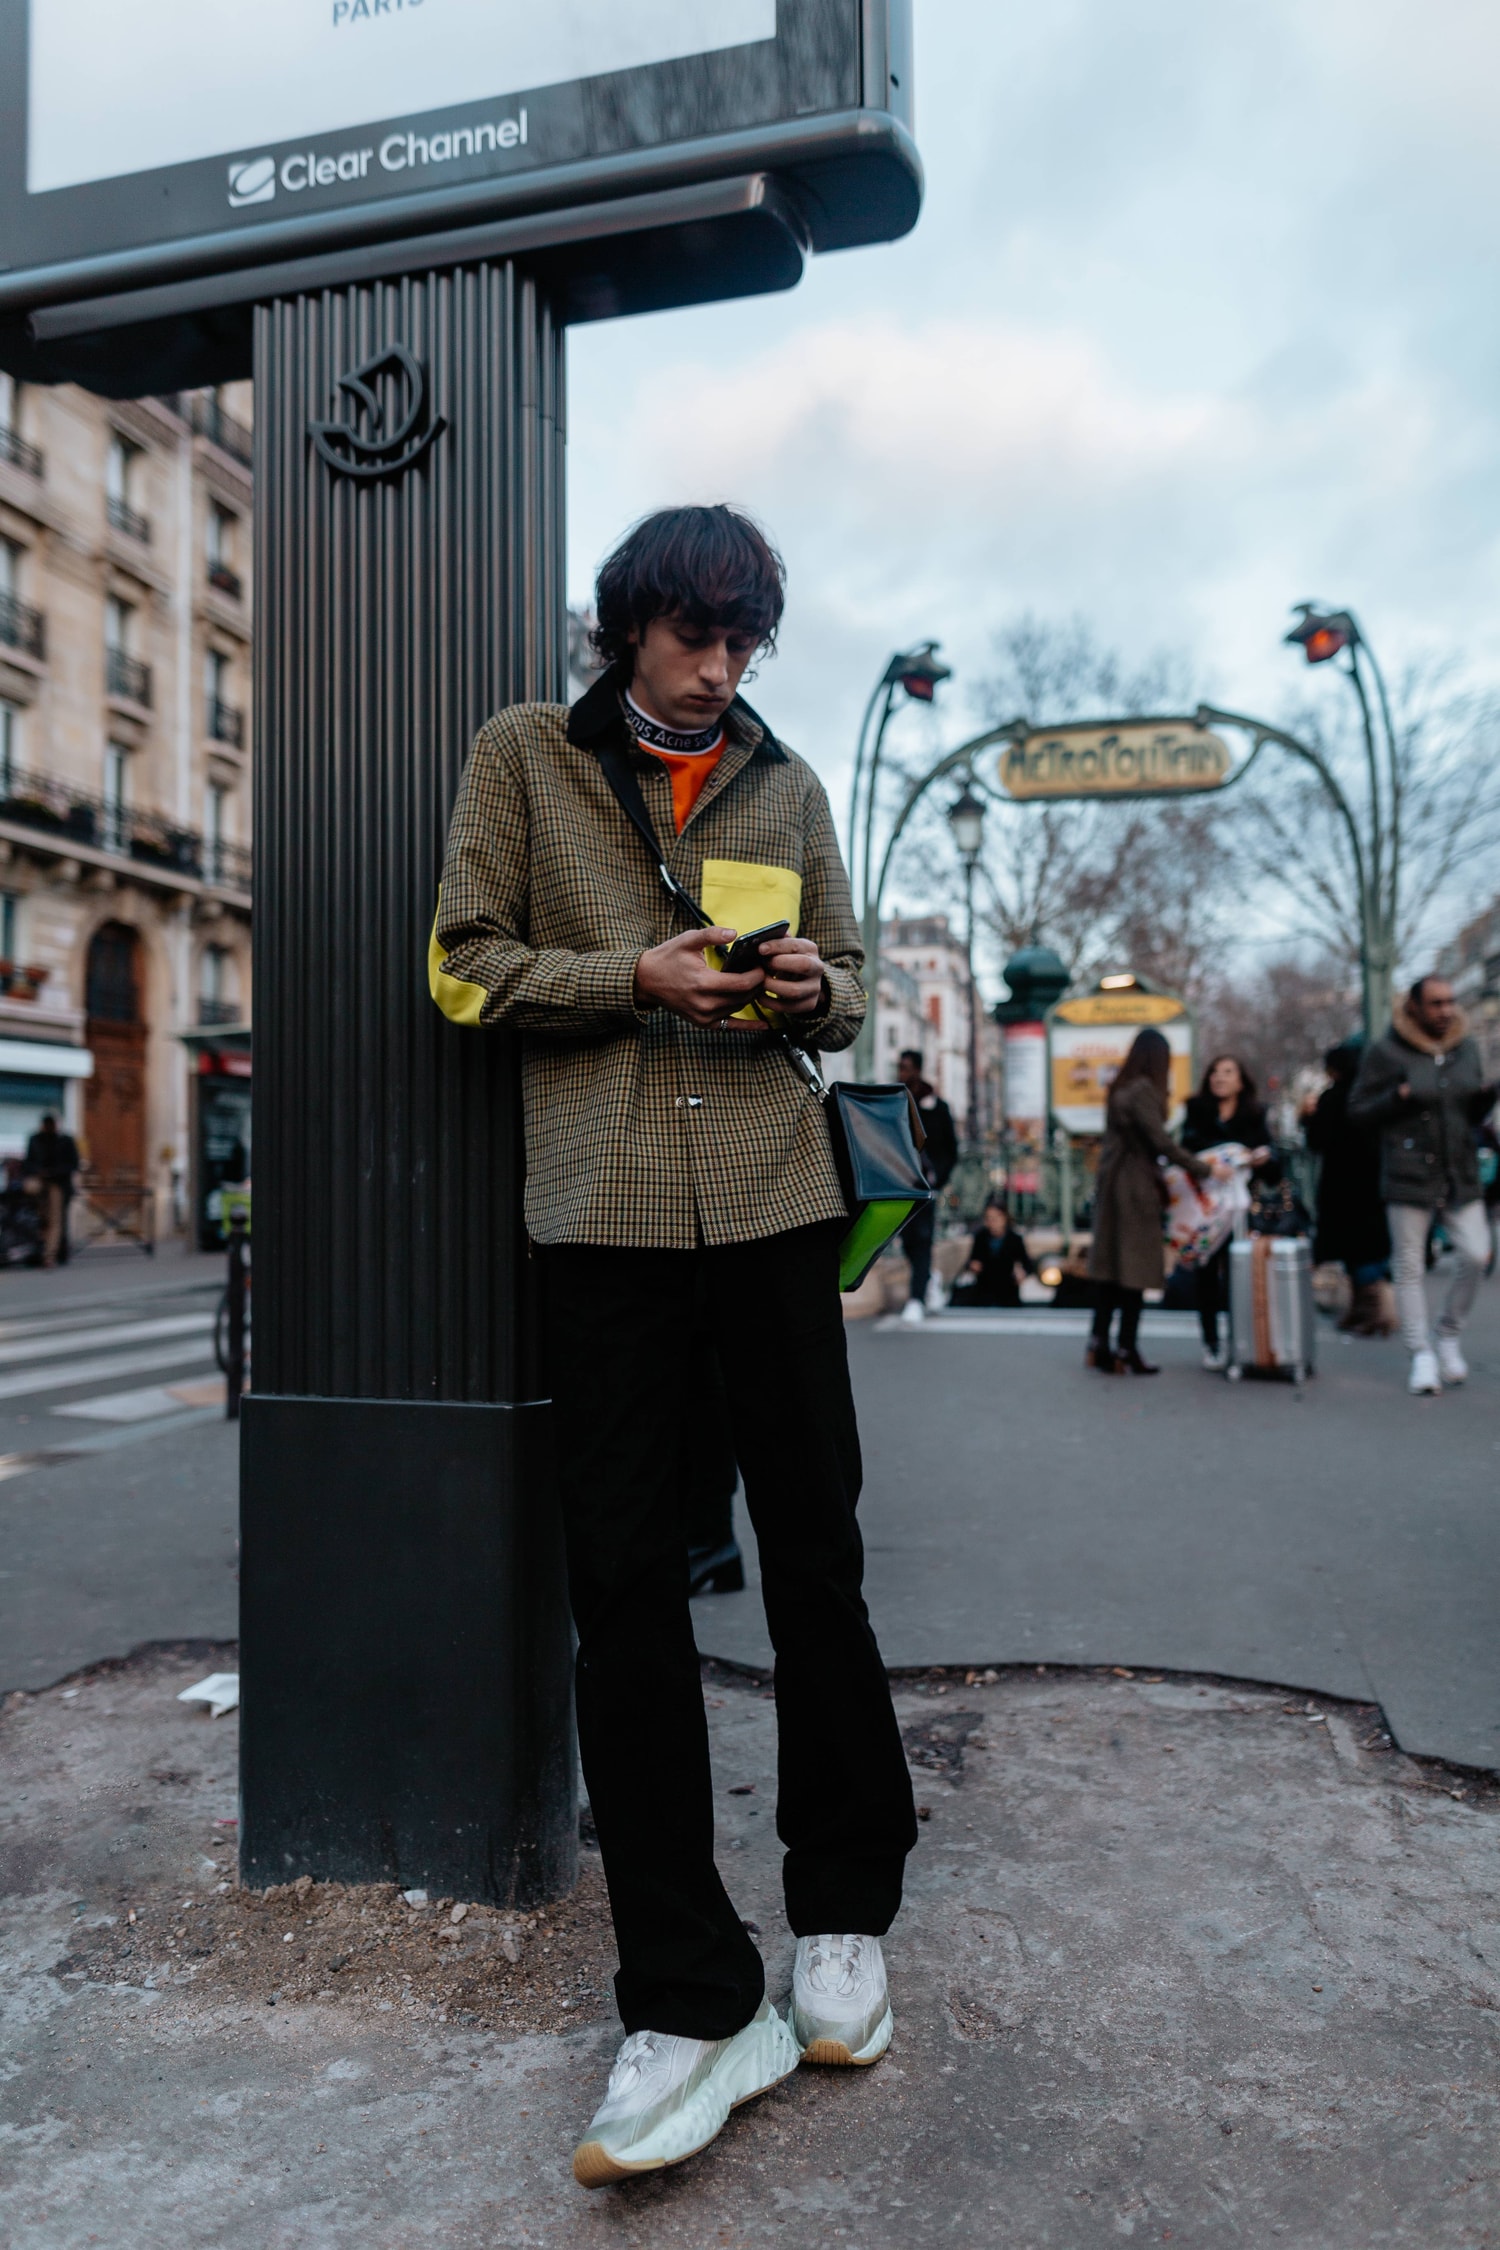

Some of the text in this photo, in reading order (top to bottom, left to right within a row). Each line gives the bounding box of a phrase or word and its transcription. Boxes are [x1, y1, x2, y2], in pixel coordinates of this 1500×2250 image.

[281, 107, 528, 192] Clear Channel
[654, 730, 692, 748] Acne
